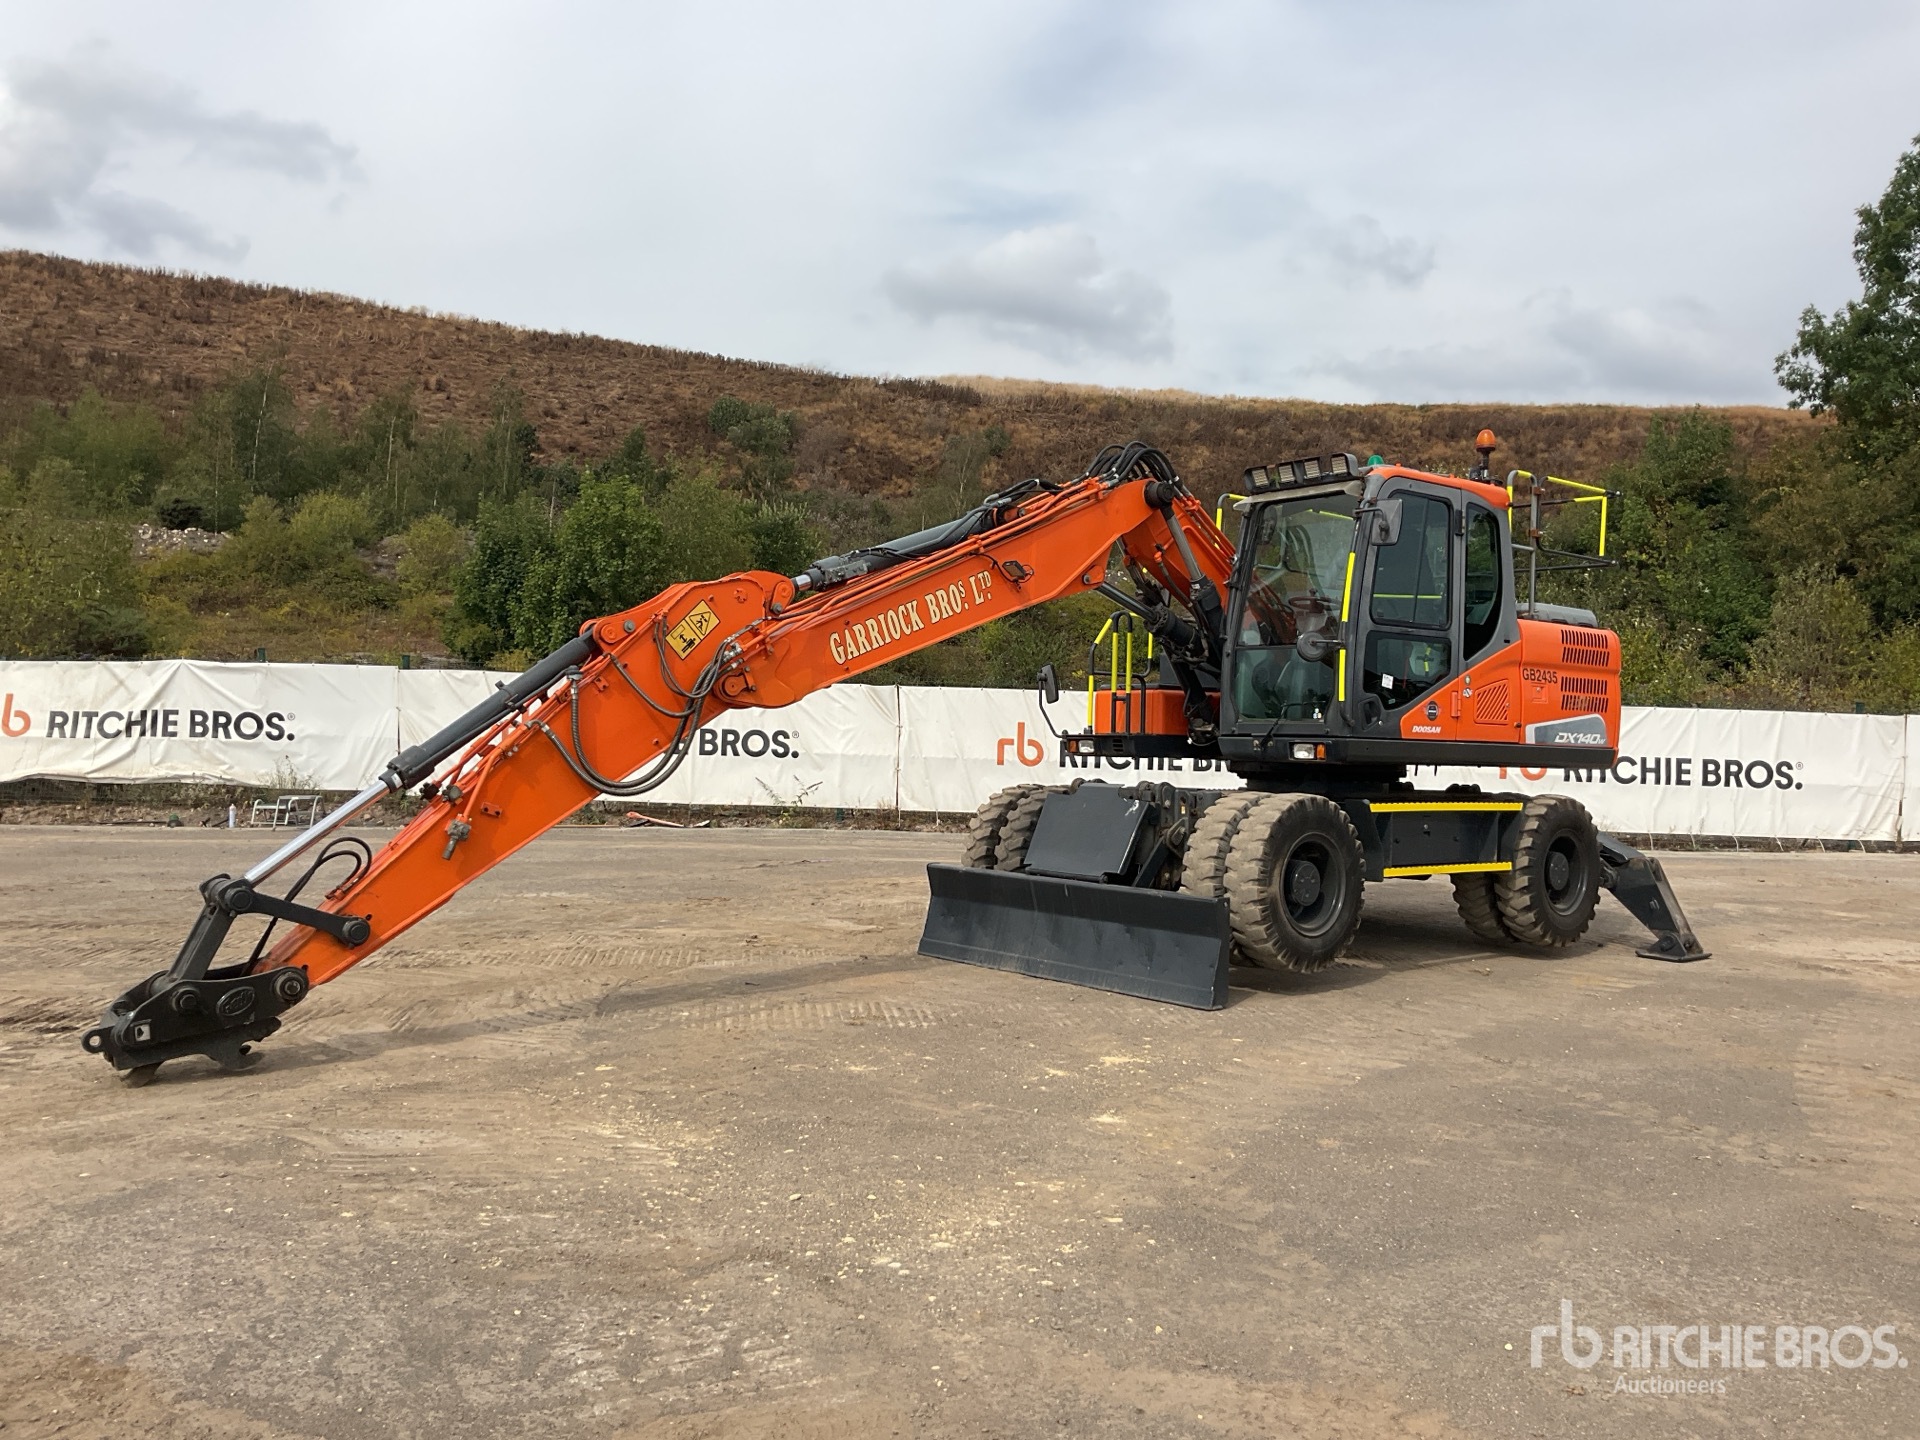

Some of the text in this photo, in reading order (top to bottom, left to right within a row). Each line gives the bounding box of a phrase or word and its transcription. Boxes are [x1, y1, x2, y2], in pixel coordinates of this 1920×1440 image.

[829, 599, 925, 665] GARRIOCK
[1522, 668, 1558, 684] GB2435
[46, 709, 179, 739] RITCHIE
[1411, 725, 1442, 734] DOOSAN
[997, 722, 1044, 767] rb
